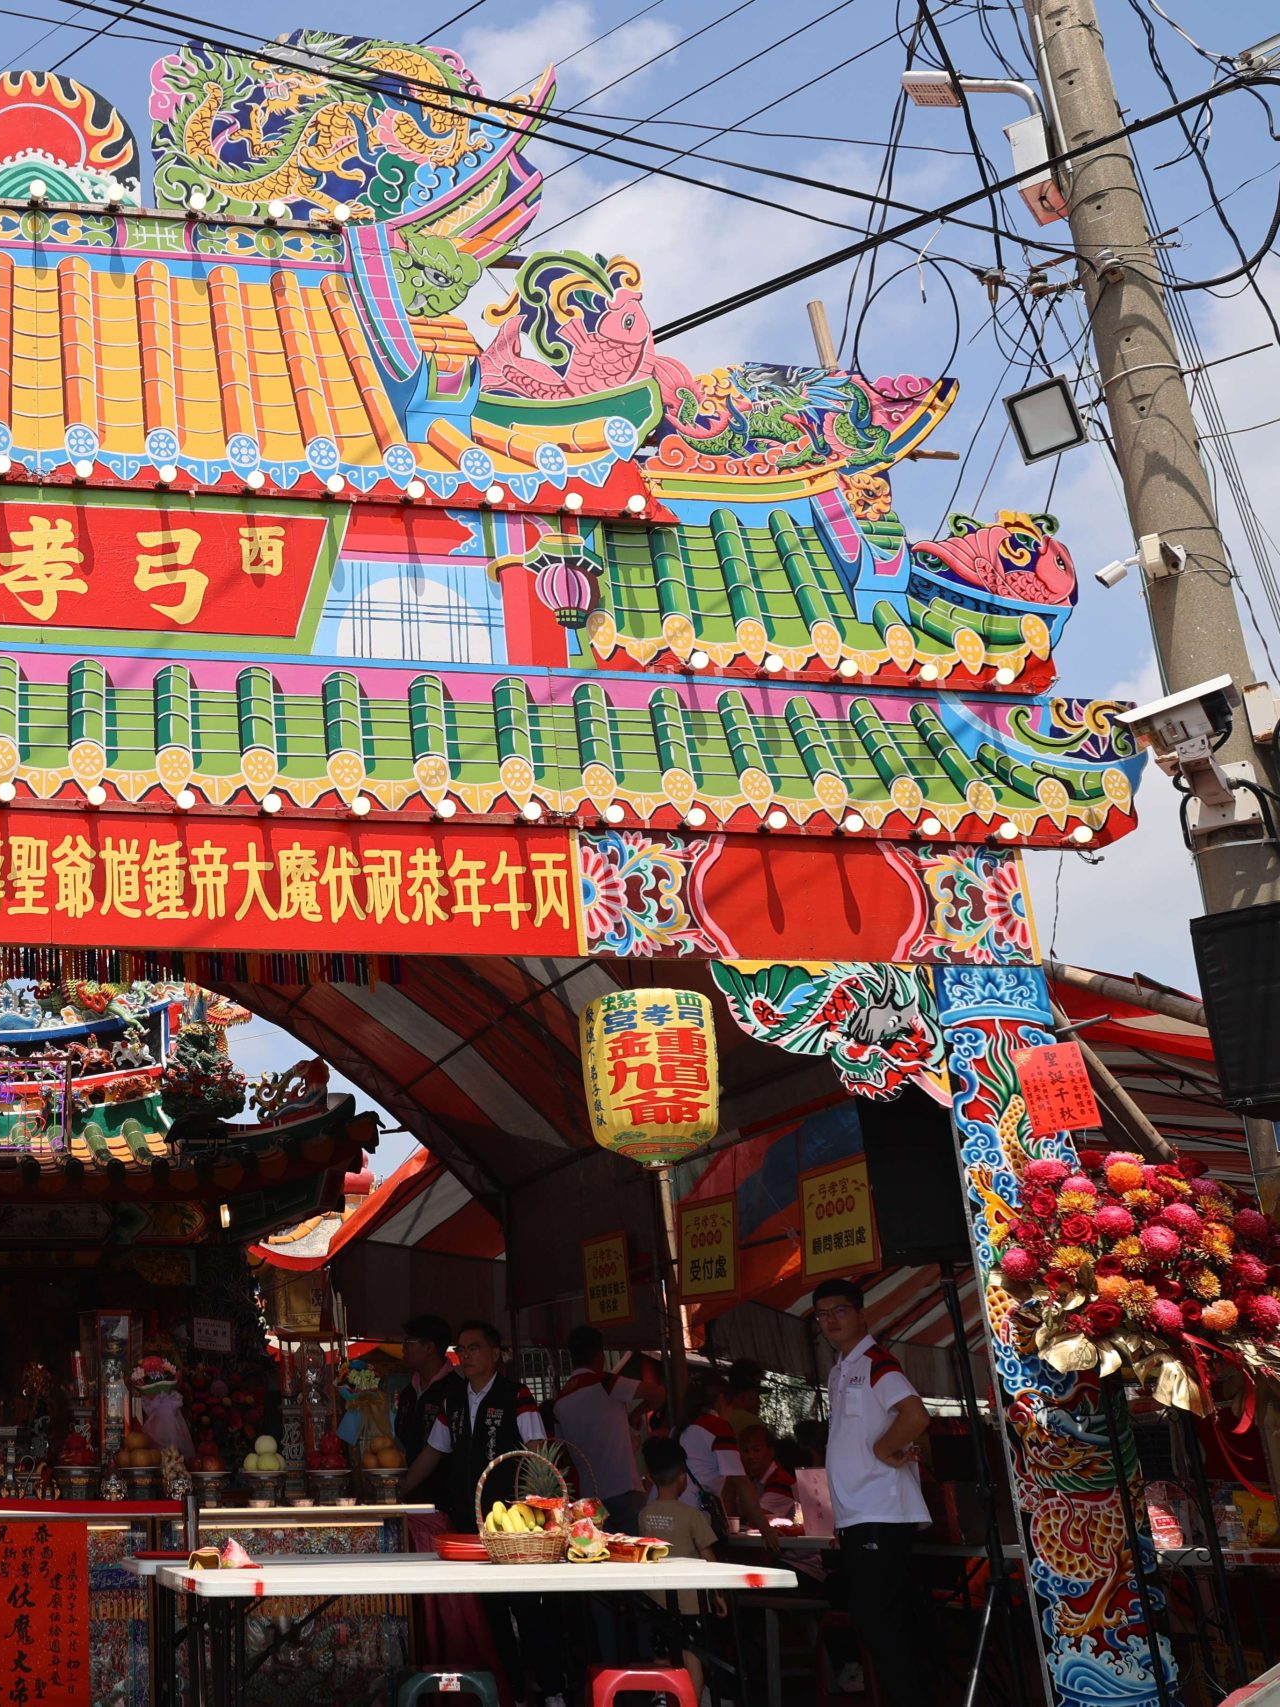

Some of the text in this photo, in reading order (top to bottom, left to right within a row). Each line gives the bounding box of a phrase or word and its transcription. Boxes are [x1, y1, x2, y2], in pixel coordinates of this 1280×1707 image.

[1043, 1052, 1078, 1123] 聖誕千秋
[689, 1255, 727, 1283] 受付處
[5, 1583, 36, 1706] 伏魔大帝
